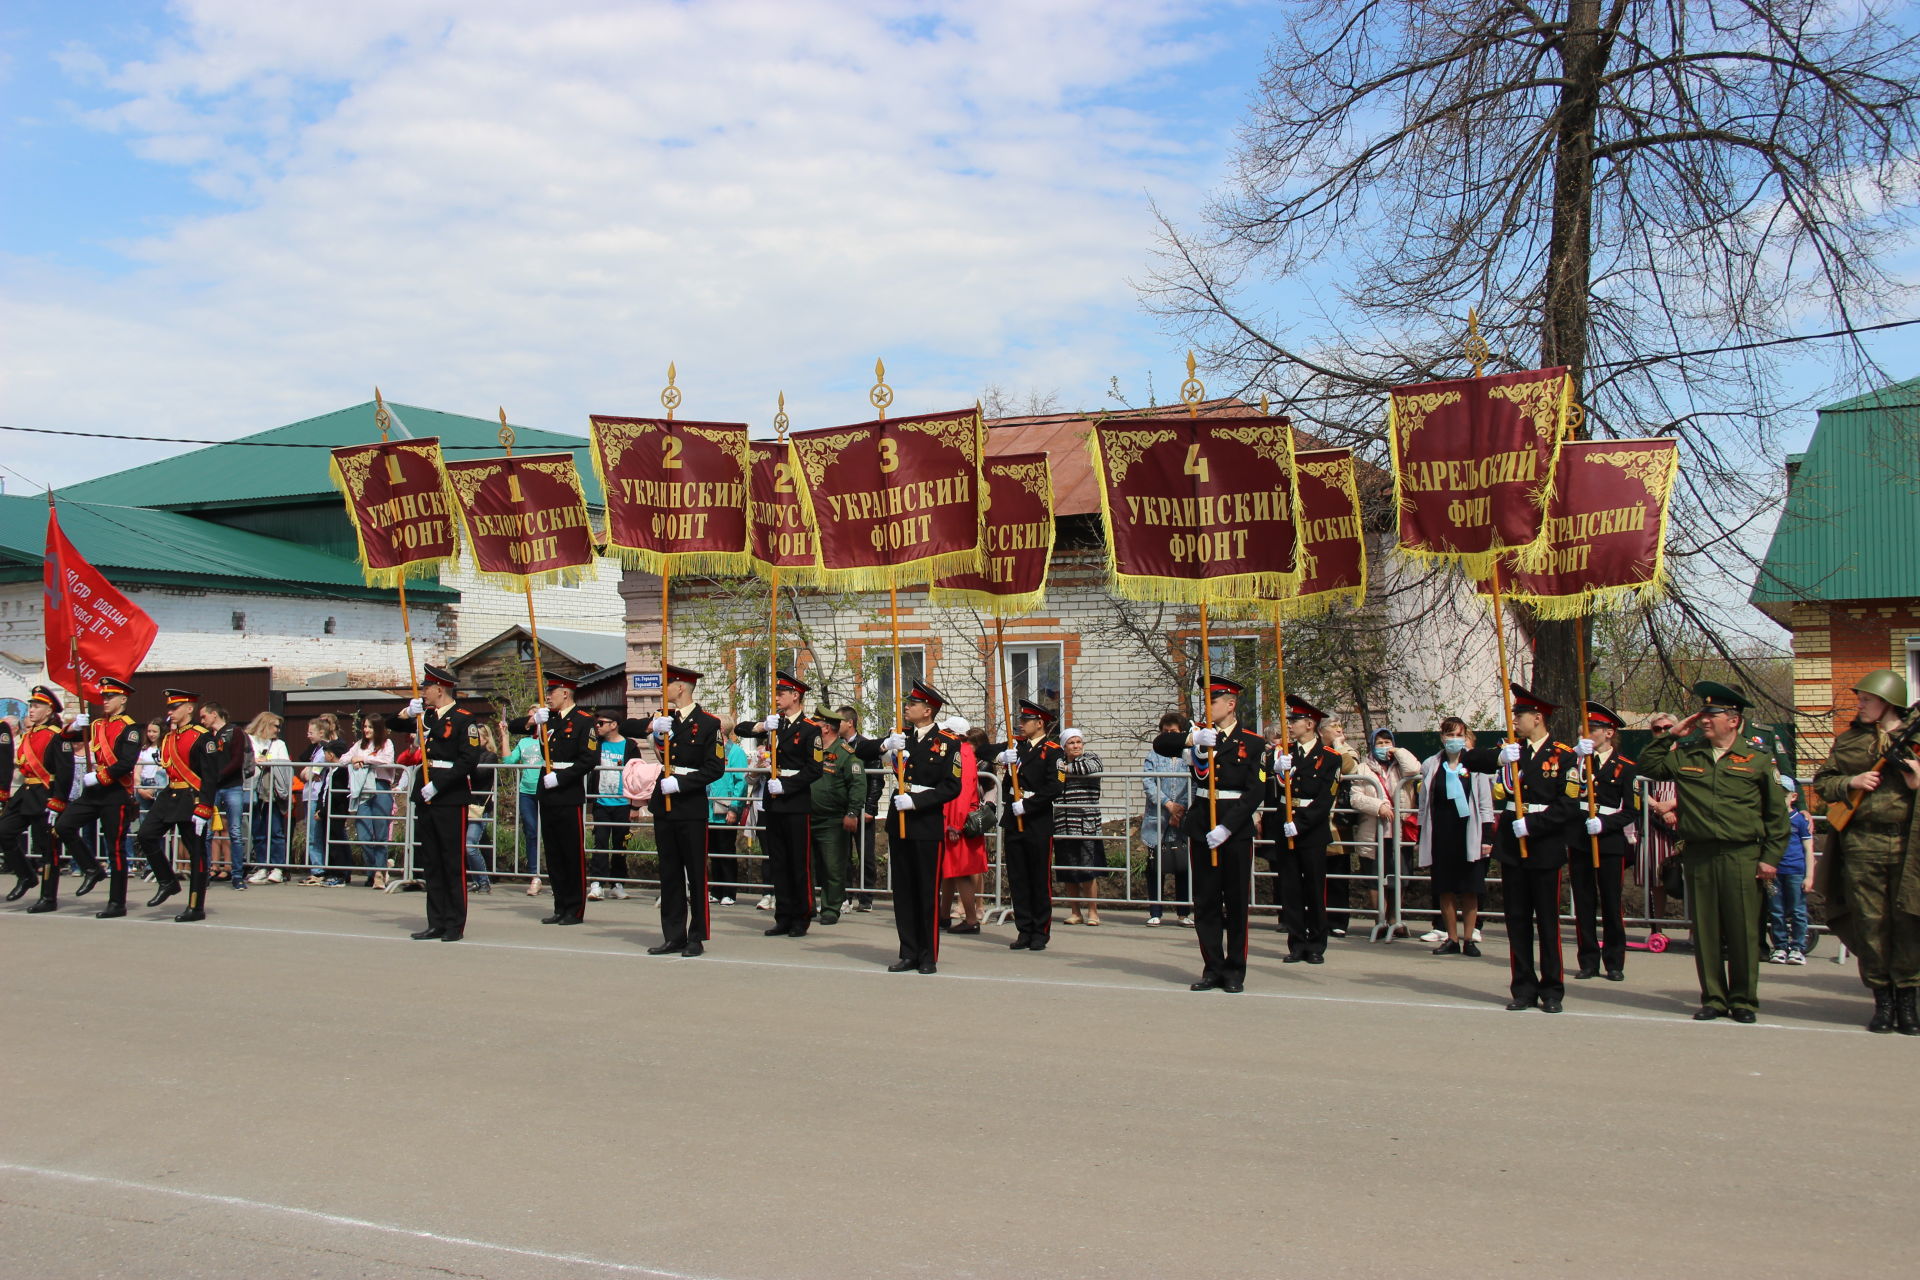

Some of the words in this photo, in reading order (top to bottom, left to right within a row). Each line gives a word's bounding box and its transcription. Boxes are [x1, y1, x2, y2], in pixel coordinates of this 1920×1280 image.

[661, 435, 683, 469] 2
[878, 438, 899, 473] 3
[1183, 443, 1210, 483] 4
[1407, 441, 1538, 492] КАРЕЛЬСКИЙ
[384, 454, 407, 486] 1
[773, 463, 793, 493] 2
[508, 474, 525, 503] 1
[620, 476, 743, 508] УКРАИНСКИЙ
[1126, 483, 1288, 526] УКРАИНСКИЙ
[1447, 495, 1491, 528] ФРНТ
[1549, 500, 1647, 544] ГРАДСКИЙ
[1169, 529, 1248, 563] ФРОНТ
